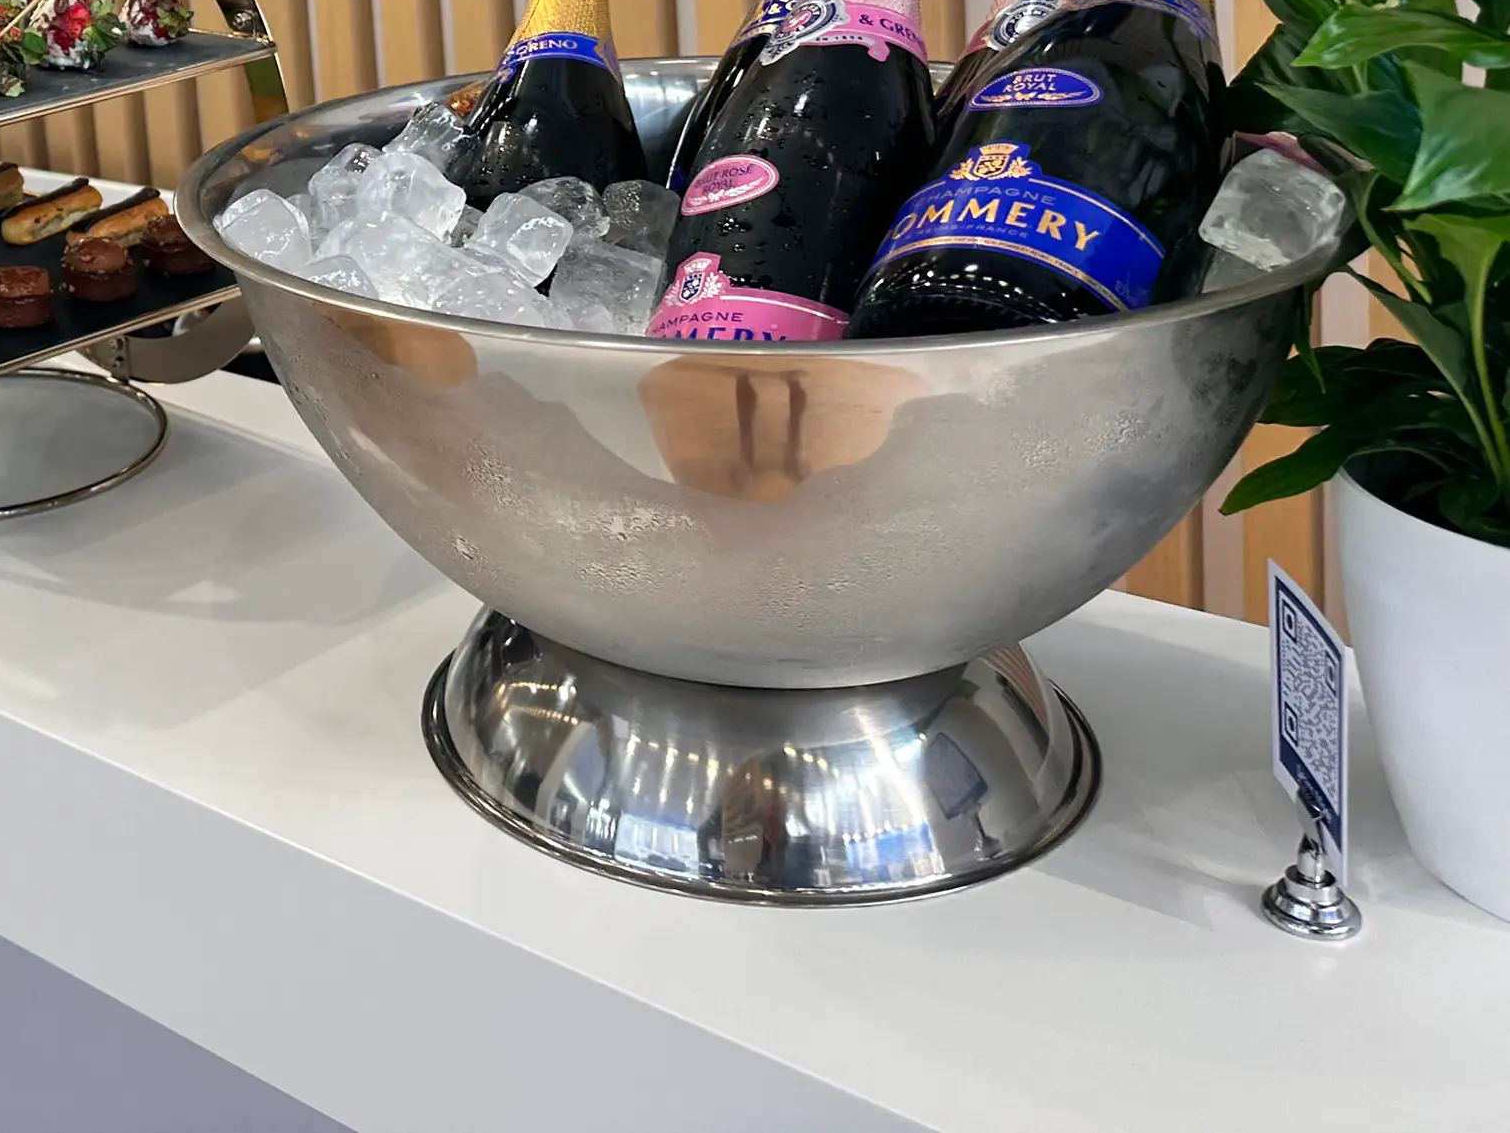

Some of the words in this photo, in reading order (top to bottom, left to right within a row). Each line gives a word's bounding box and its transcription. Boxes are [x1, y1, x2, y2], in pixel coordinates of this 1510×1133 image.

[858, 14, 874, 26] &
[1013, 73, 1057, 84] BRUT
[1002, 82, 1057, 93] ROYAL
[914, 186, 1057, 208] CHAMPAGNE
[889, 197, 1101, 253] OMMERY
